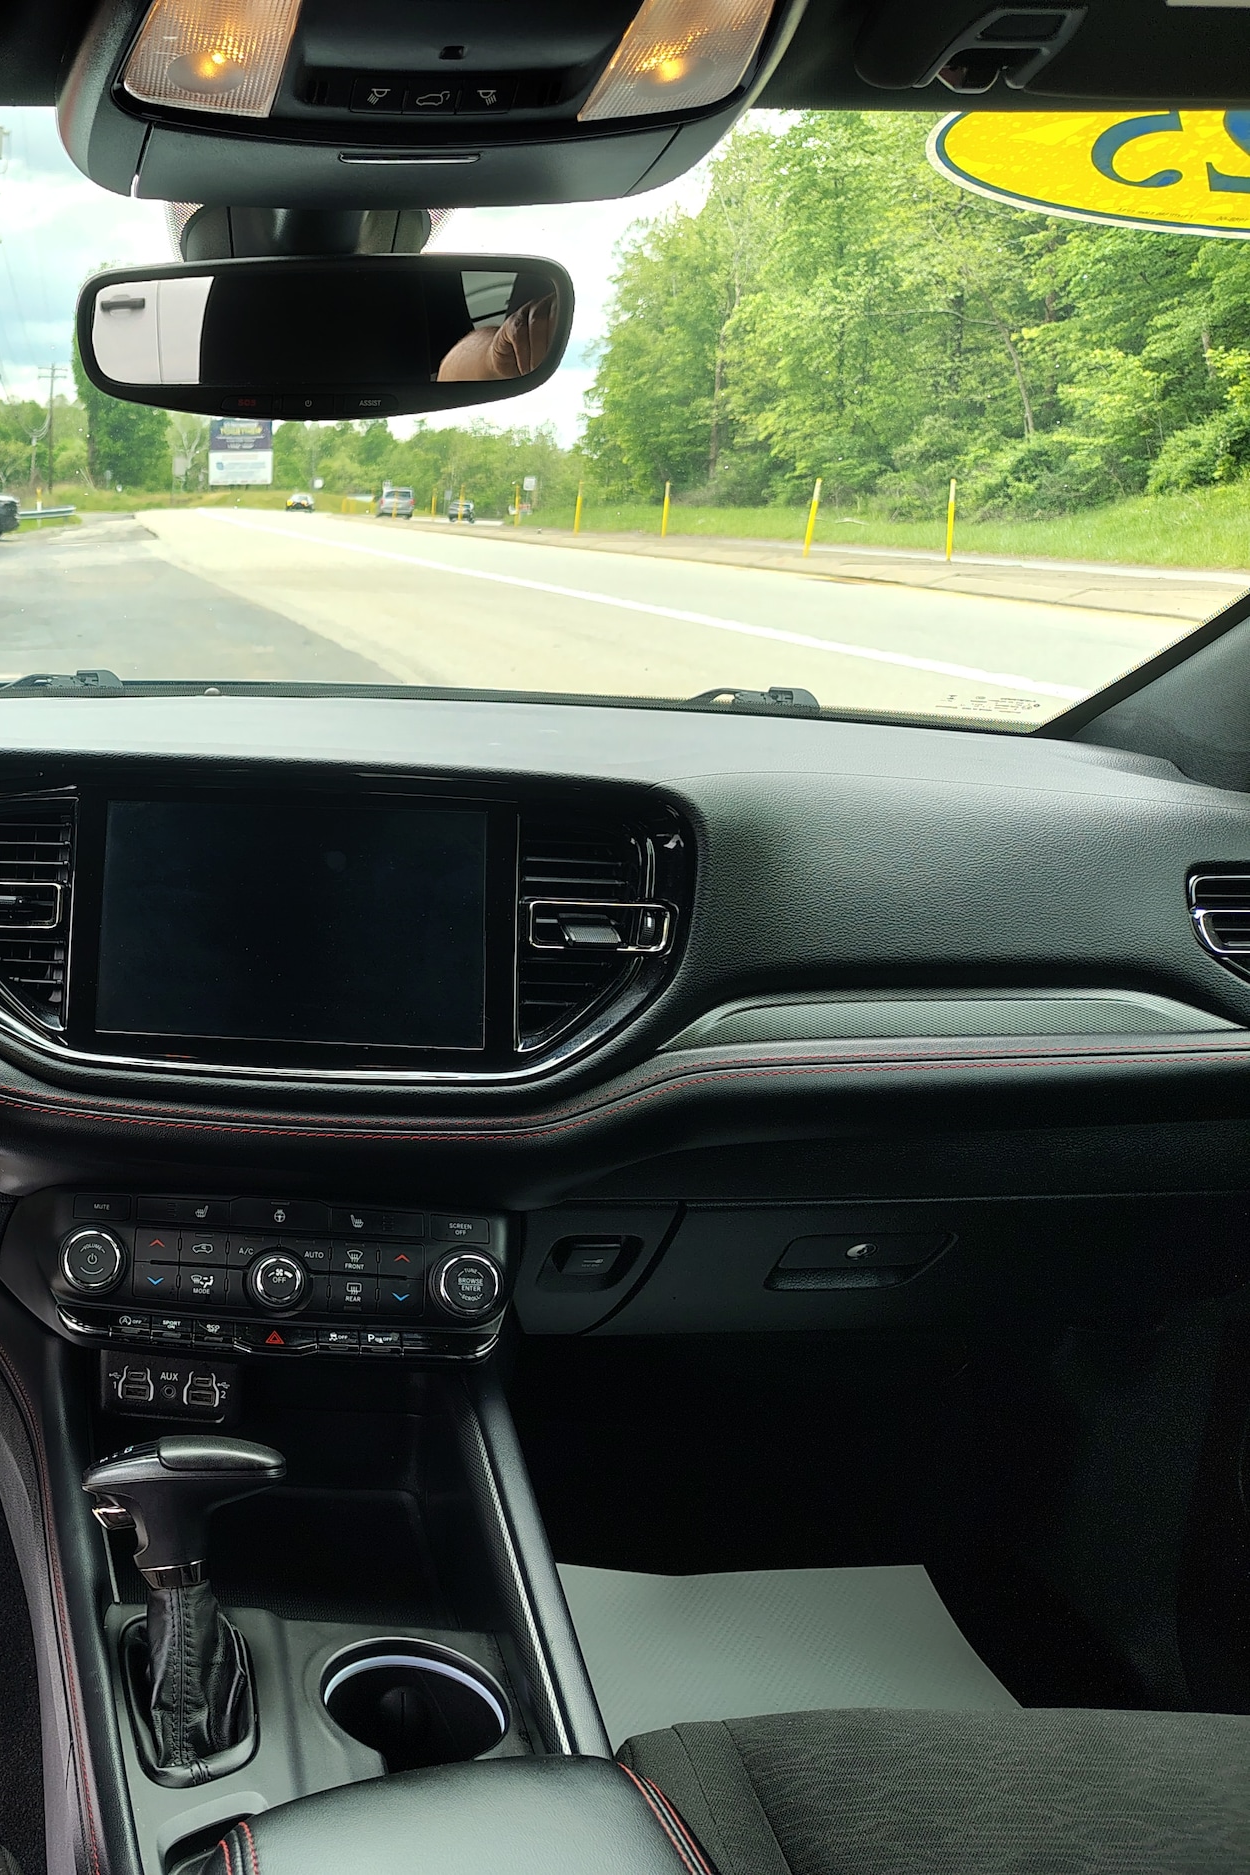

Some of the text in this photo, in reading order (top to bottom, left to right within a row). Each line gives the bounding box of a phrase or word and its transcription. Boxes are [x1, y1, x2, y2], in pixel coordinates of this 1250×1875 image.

[358, 399, 382, 407] ASSIST
[449, 1222, 473, 1230] SCREEN
[238, 1247, 255, 1256] A/C
[304, 1251, 325, 1259] AUTO
[272, 1276, 287, 1284] OFF
[192, 1287, 210, 1295] MODE
[345, 1295, 362, 1303] REAR
[160, 1371, 179, 1381] AUX
[112, 1381, 117, 1390] 1
[220, 1390, 227, 1399] 2
